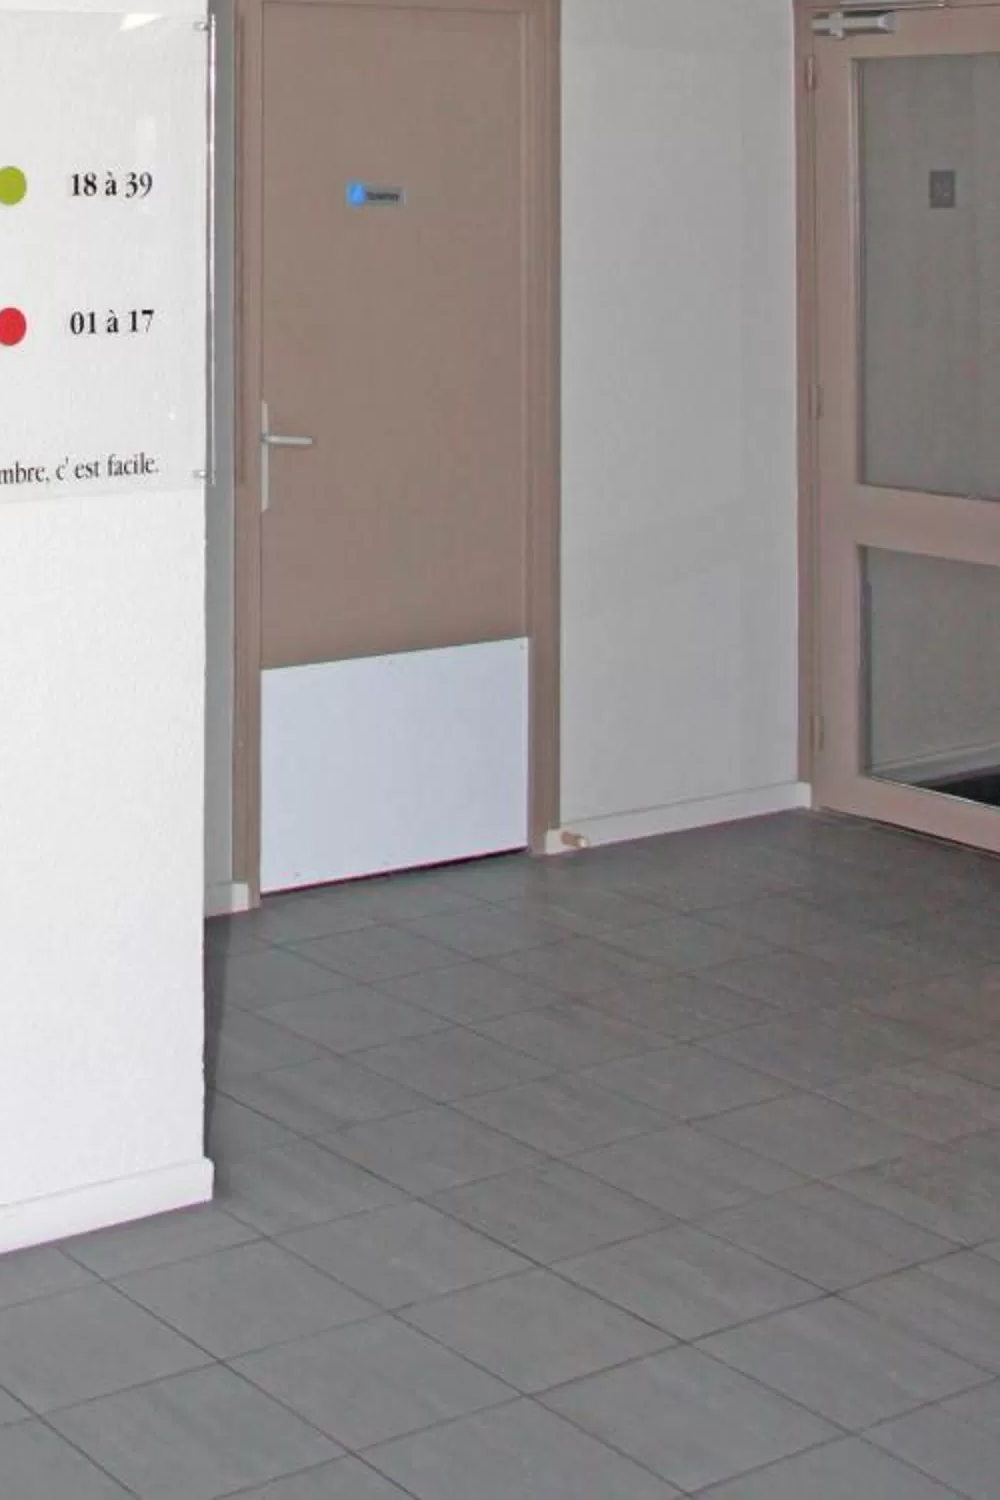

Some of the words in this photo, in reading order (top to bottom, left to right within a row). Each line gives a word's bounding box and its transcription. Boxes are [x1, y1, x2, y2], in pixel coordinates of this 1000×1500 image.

[71, 172, 98, 197] 18
[105, 171, 119, 197] à
[125, 172, 154, 199] 39
[69, 311, 98, 335] 01
[106, 309, 120, 334] à
[130, 309, 155, 334] 17
[74, 461, 101, 480] est
[106, 451, 160, 477] facile.
